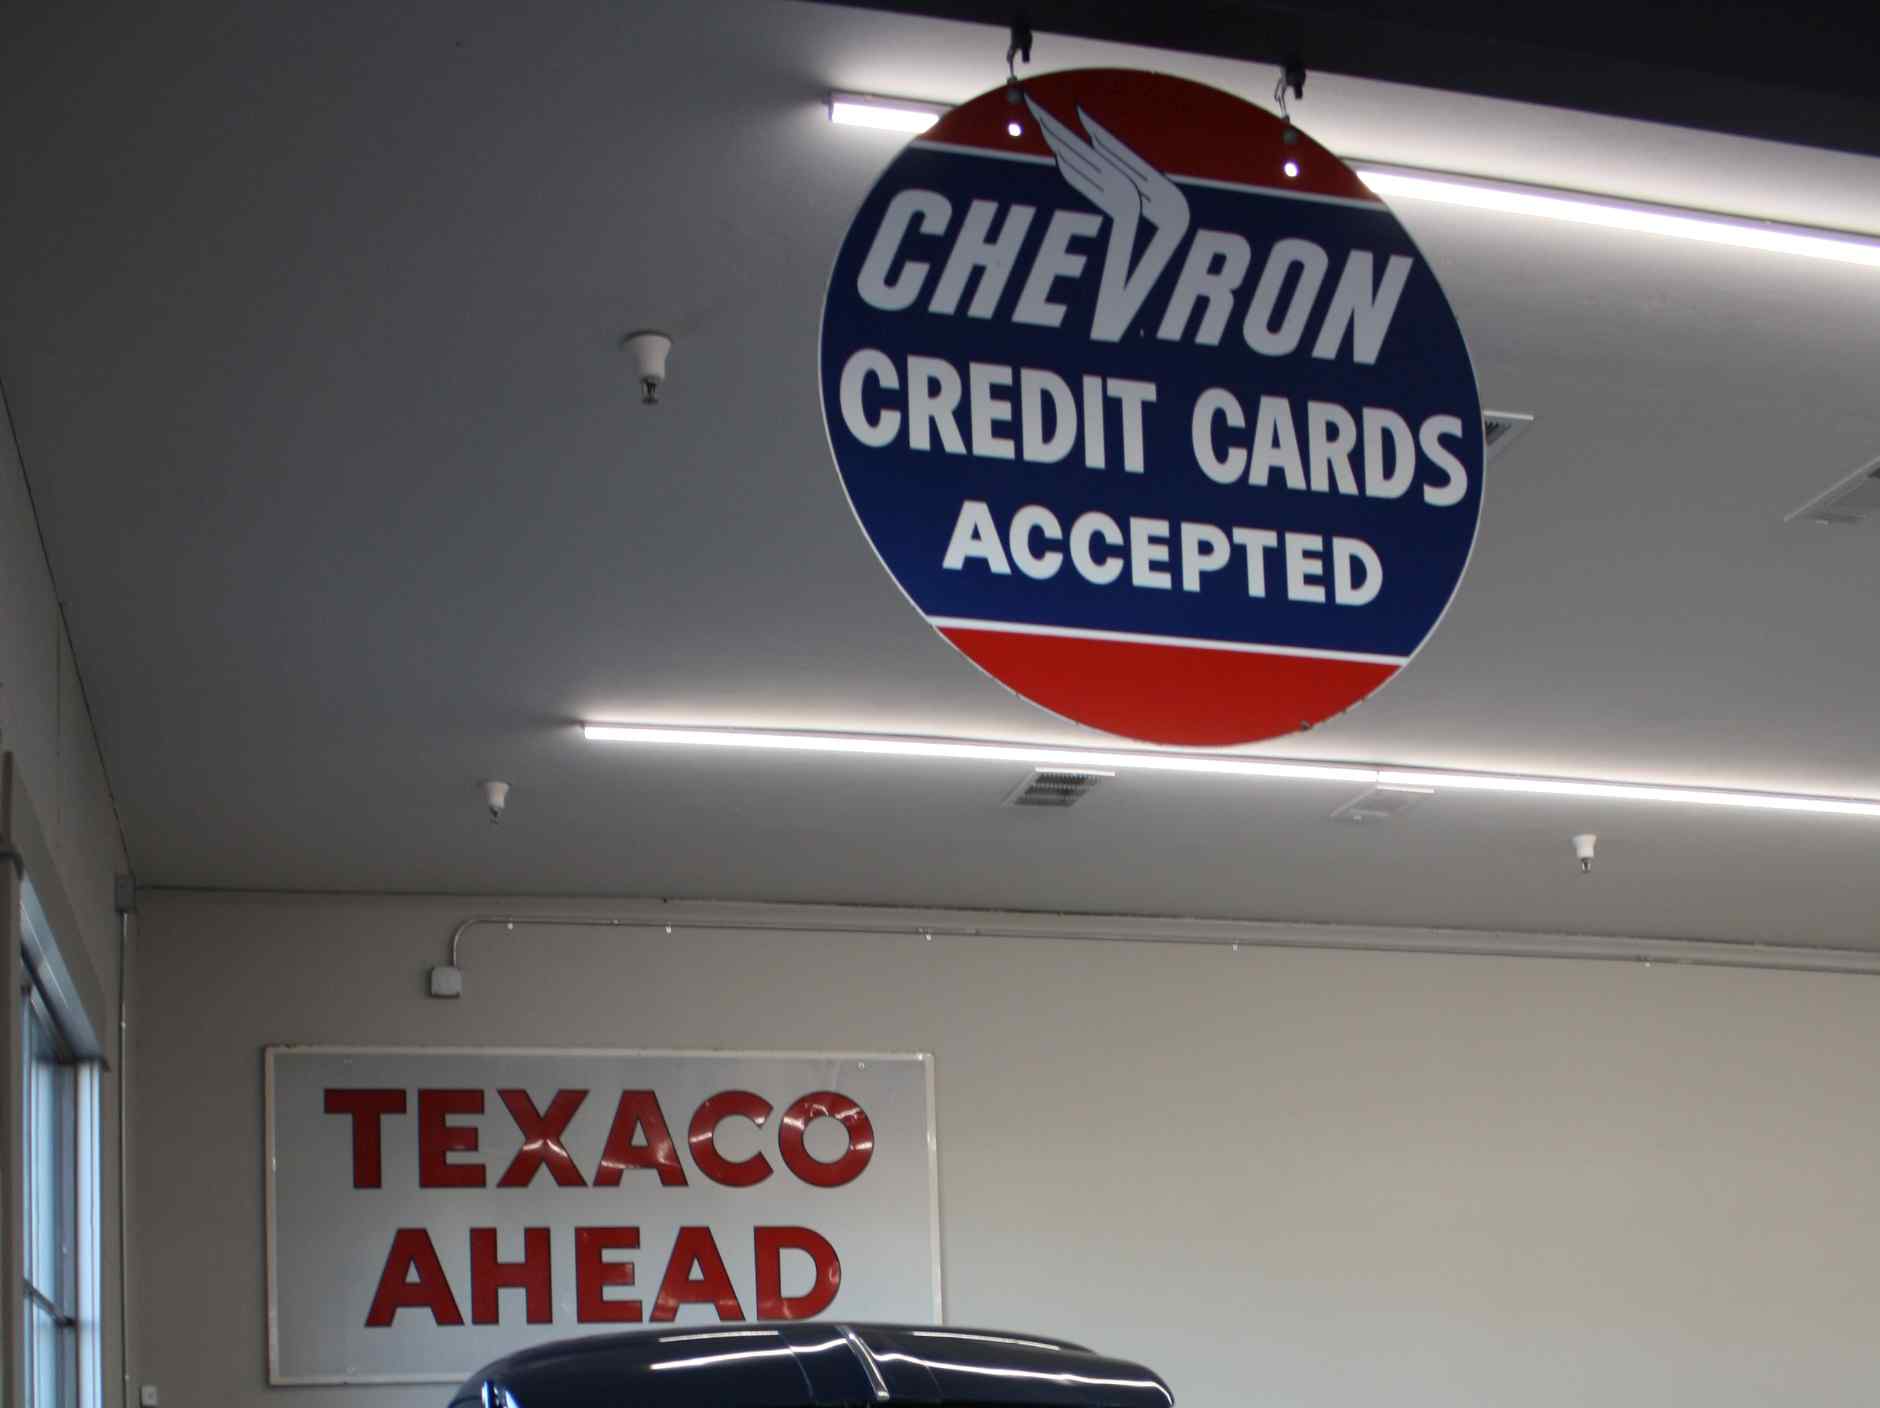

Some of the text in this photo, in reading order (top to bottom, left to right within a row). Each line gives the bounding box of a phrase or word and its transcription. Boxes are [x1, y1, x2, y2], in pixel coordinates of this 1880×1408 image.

[857, 170, 1413, 366] CHEVRON
[839, 347, 1469, 507] CREDIT CARDS
[942, 500, 1384, 607] ACCEPTED
[323, 1089, 875, 1189] TEXACO
[364, 1225, 842, 1328] AHEAD
